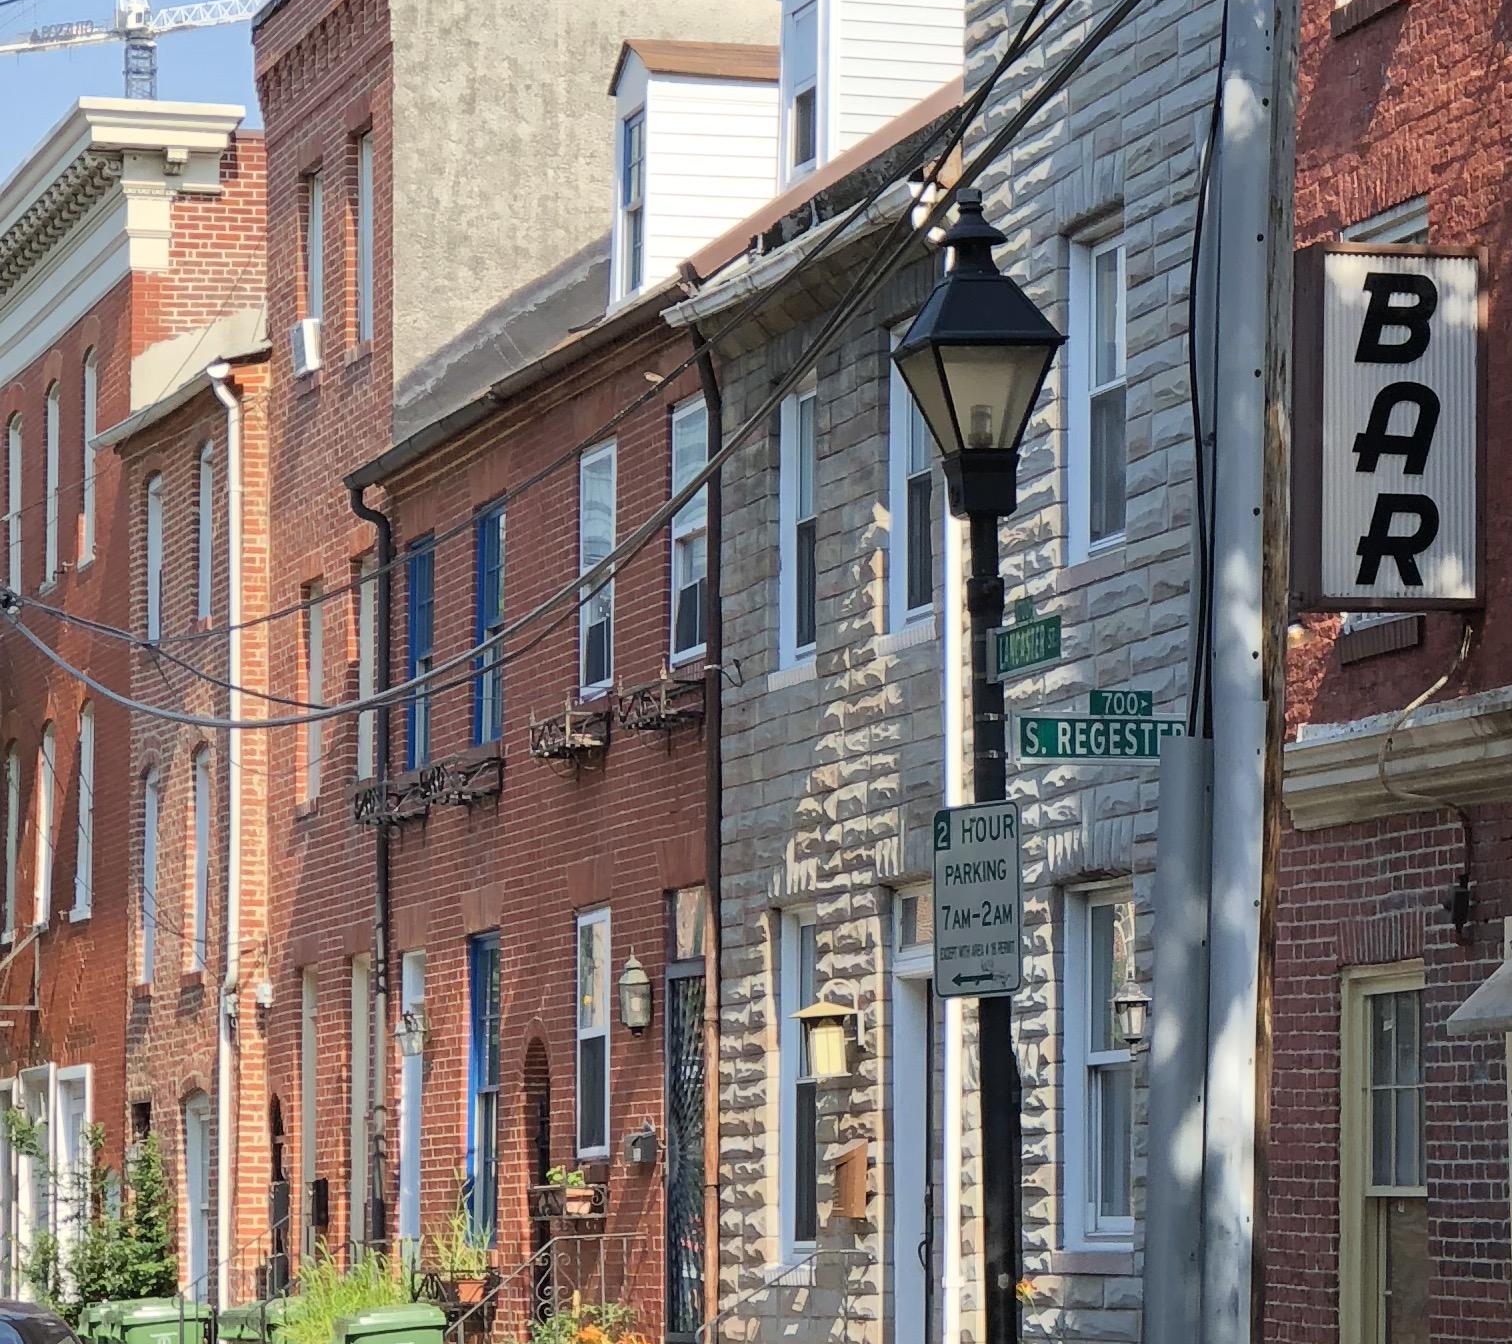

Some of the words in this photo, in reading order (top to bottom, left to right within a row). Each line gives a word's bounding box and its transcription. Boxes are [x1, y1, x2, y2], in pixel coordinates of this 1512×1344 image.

[1352, 271, 1441, 586] BAR
[1101, 693, 1138, 714] 700
[1025, 721, 1047, 754] S.
[937, 821, 948, 848] 2
[962, 814, 1014, 844] HOUR
[945, 859, 1007, 886] PARKING
[942, 900, 1012, 930] 7AM-2AM
